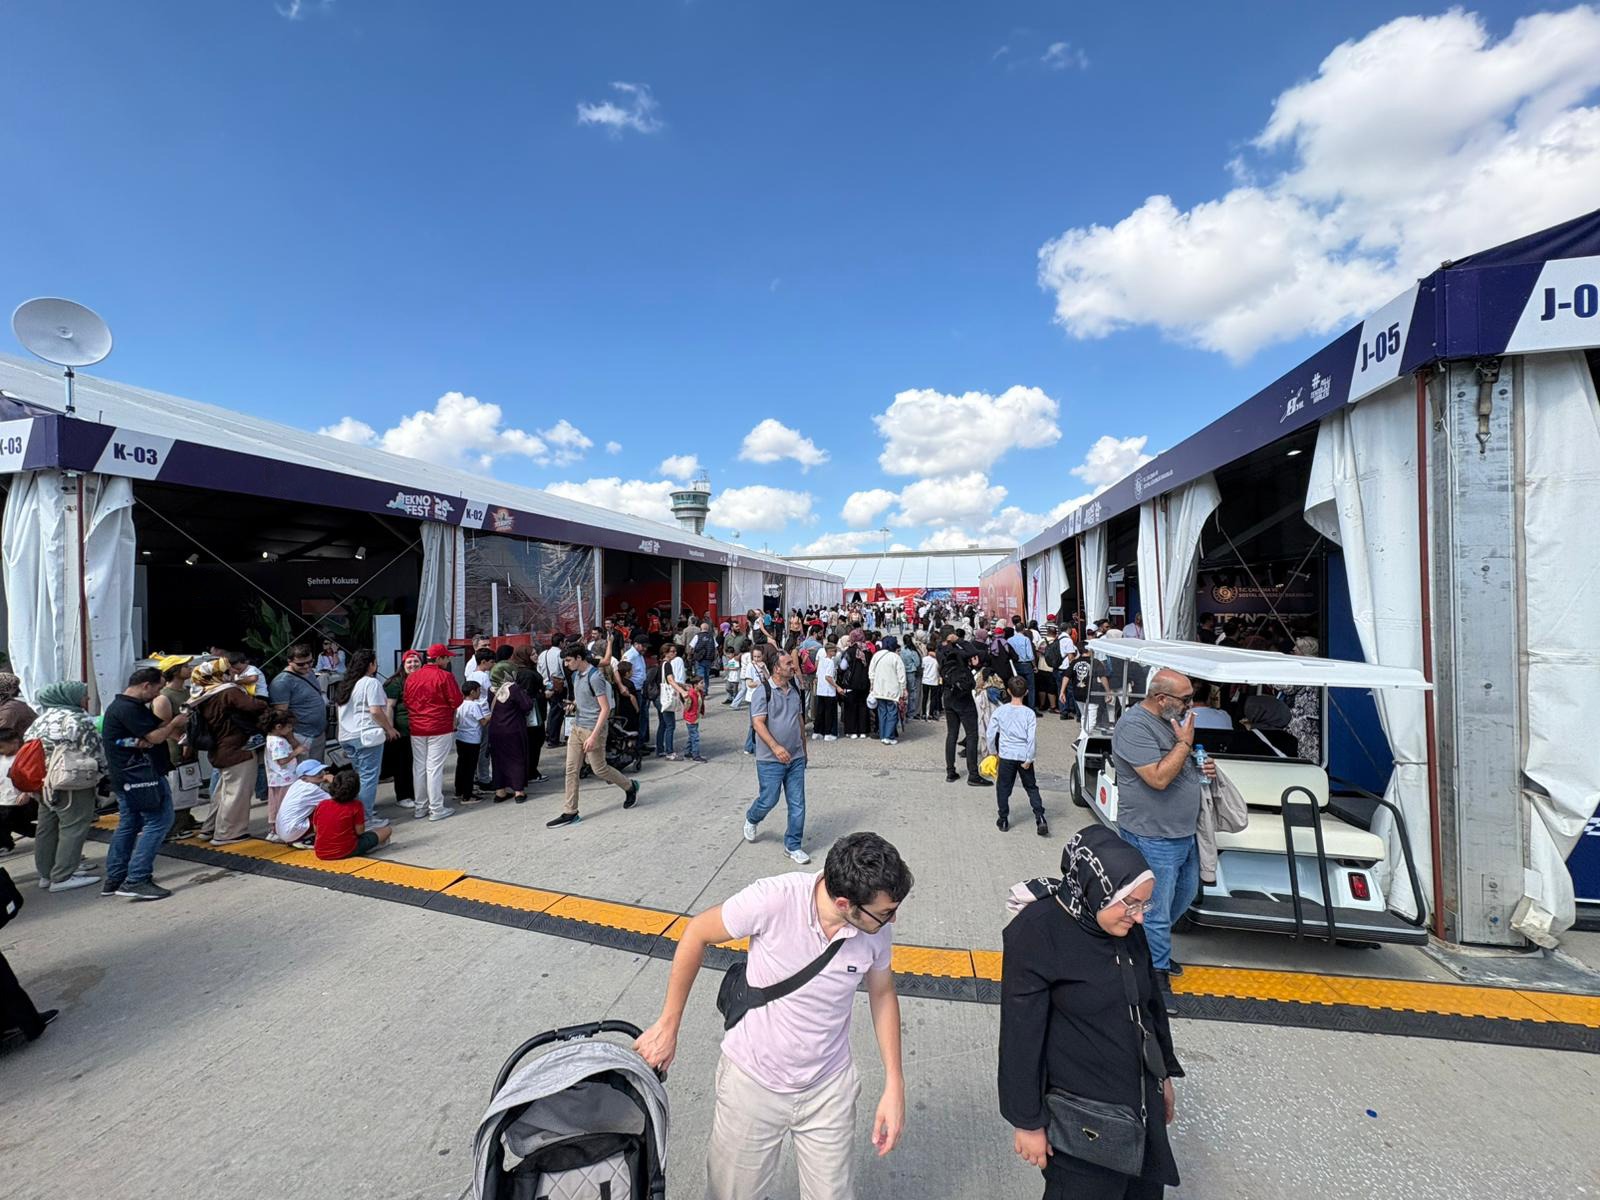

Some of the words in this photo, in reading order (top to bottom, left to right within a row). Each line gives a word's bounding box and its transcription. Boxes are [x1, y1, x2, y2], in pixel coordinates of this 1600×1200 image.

[1361, 321, 1400, 372] J-05
[114, 442, 158, 466] K-03
[465, 508, 483, 521] K-02
[307, 577, 330, 588] Şehrin
[332, 576, 359, 585] Kokusu
